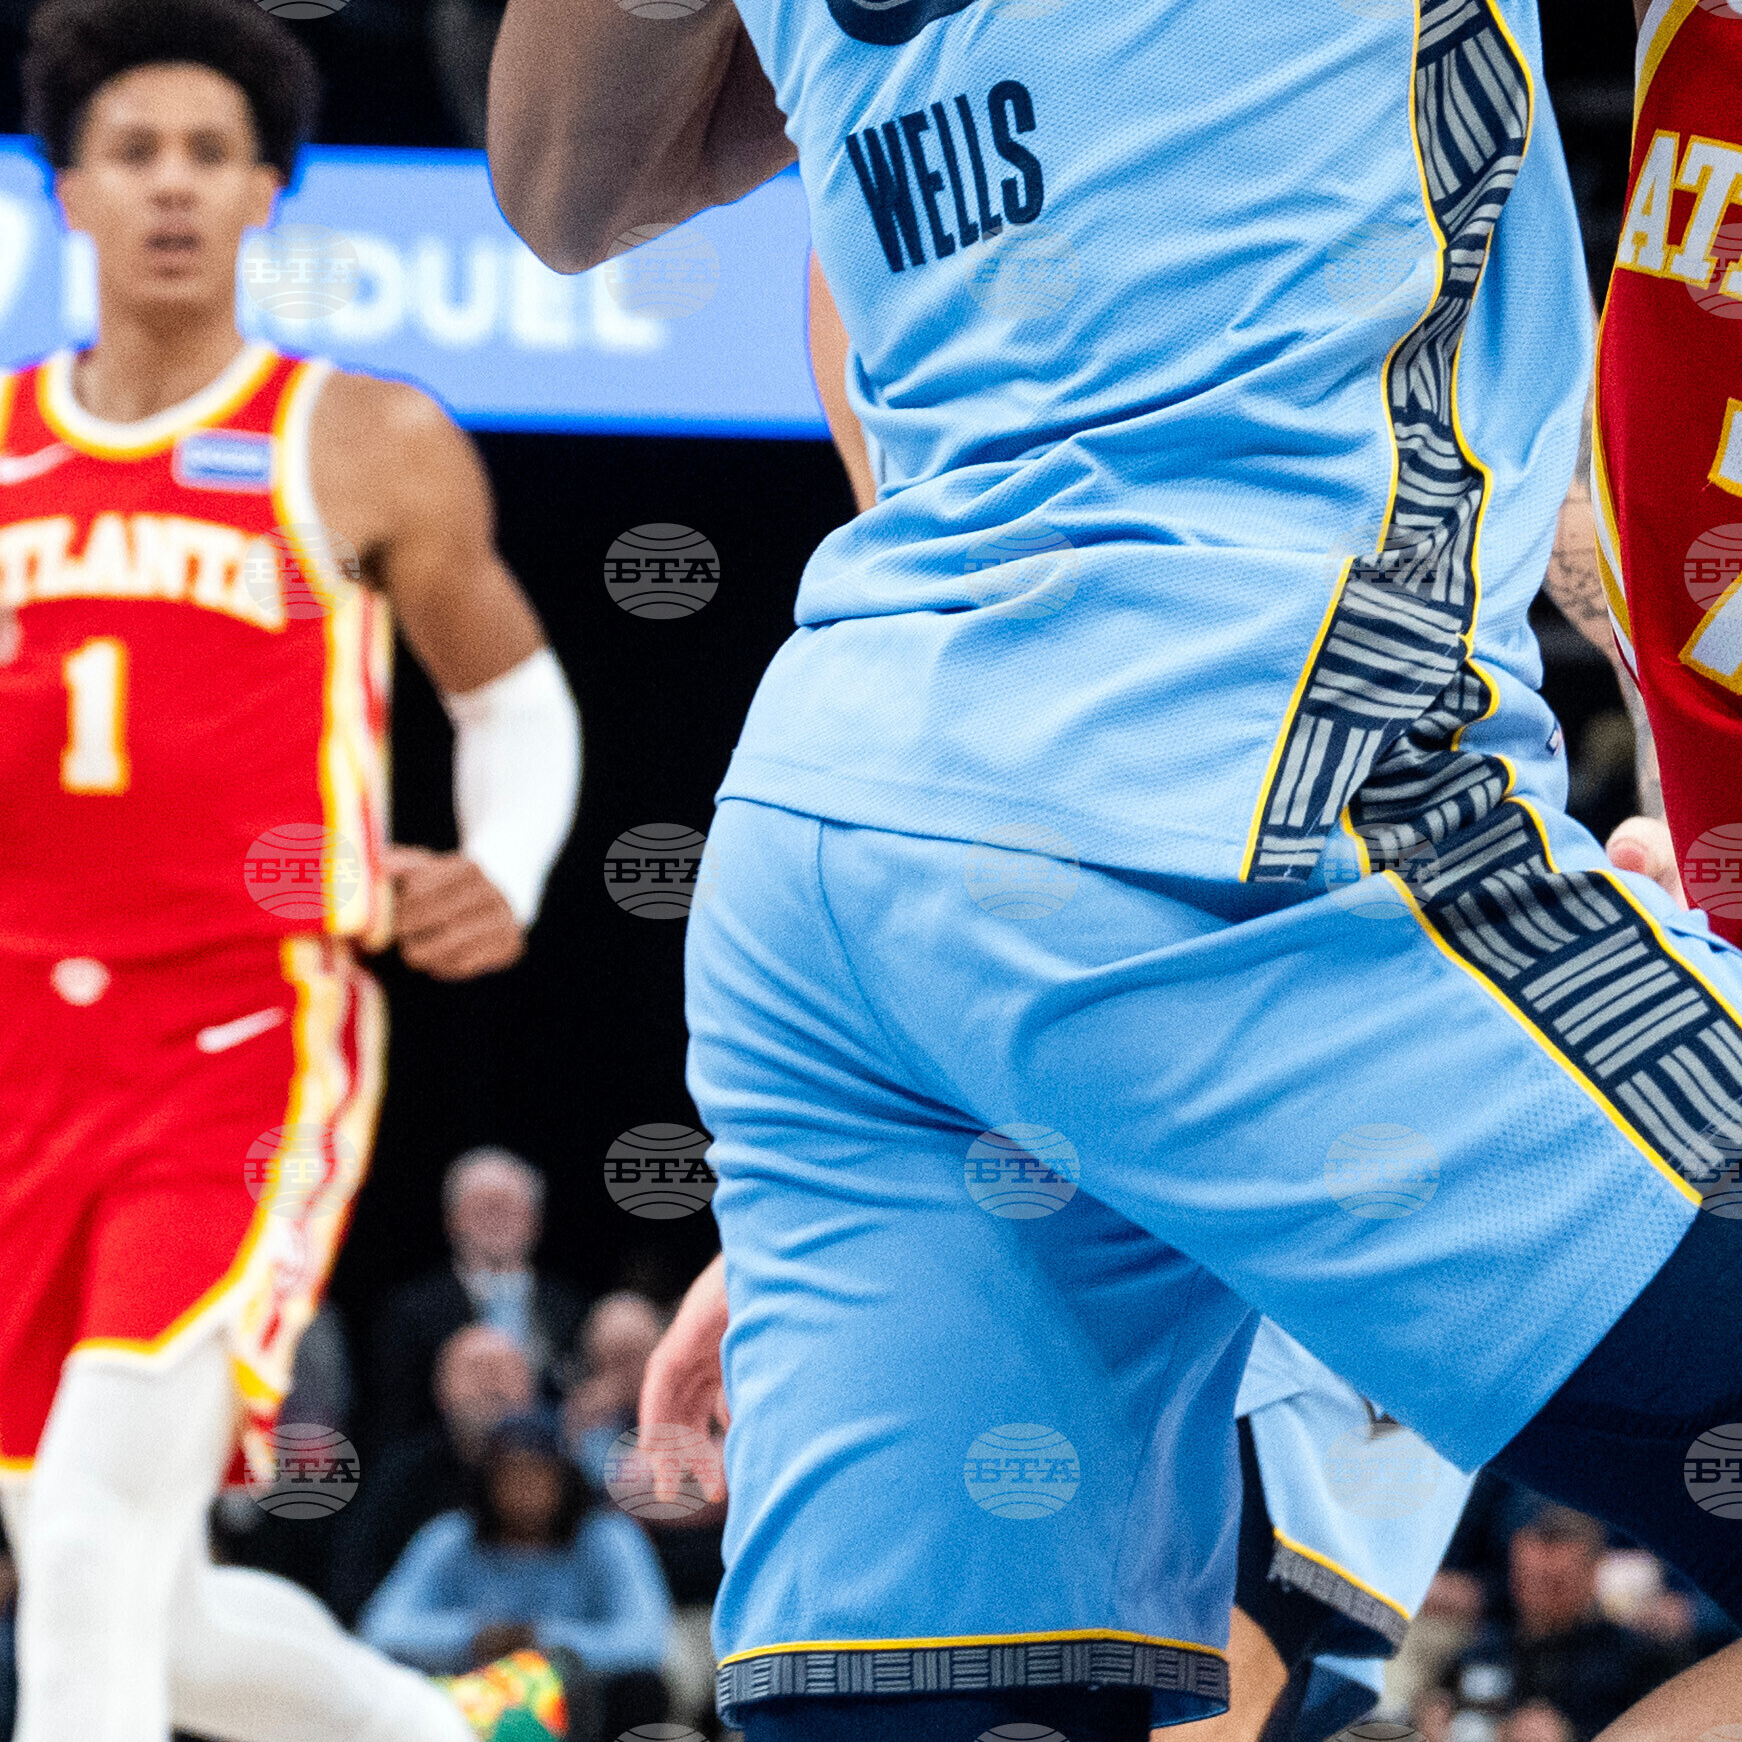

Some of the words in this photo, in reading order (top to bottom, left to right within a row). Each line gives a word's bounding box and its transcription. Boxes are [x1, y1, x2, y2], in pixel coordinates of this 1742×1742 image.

[846, 79, 1044, 273] WELLS
[0, 512, 287, 634] TLANTA
[60, 636, 129, 796] 1
